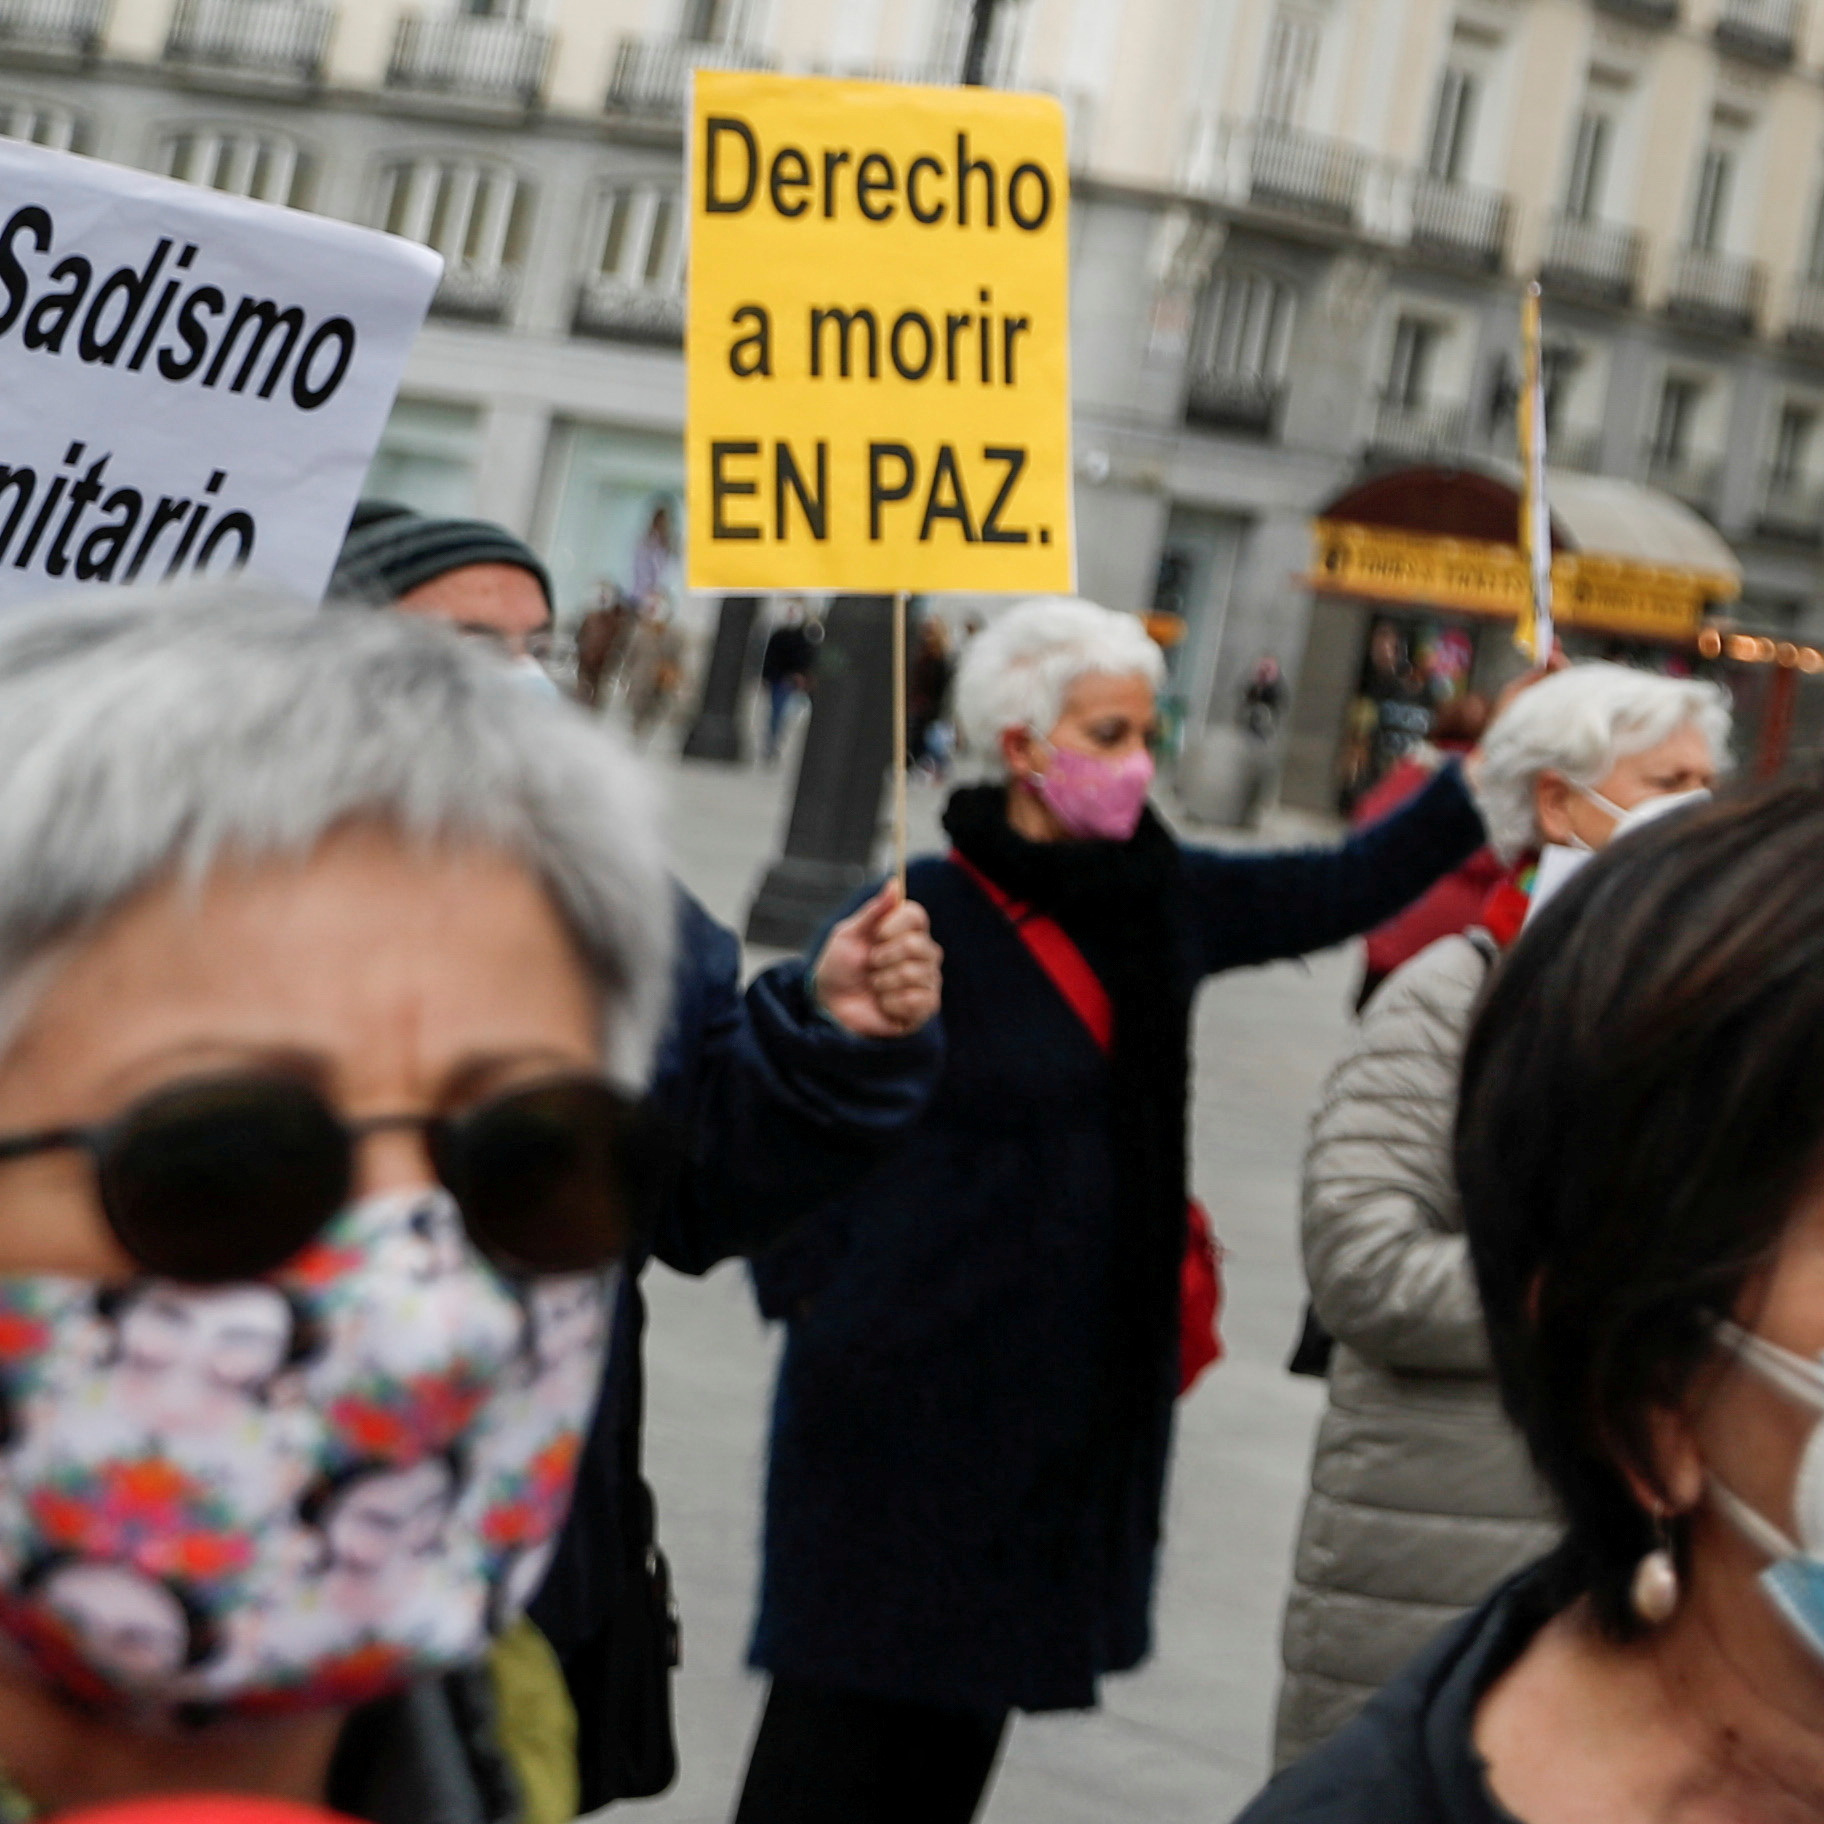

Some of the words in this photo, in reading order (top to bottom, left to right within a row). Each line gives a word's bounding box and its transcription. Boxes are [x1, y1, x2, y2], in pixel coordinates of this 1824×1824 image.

[702, 115, 1054, 233] Derecho
[0, 204, 357, 413] Sadismo
[727, 303, 774, 380] a
[808, 285, 1032, 387] morir
[710, 439, 830, 543] EN
[867, 440, 1054, 546] PAZ.
